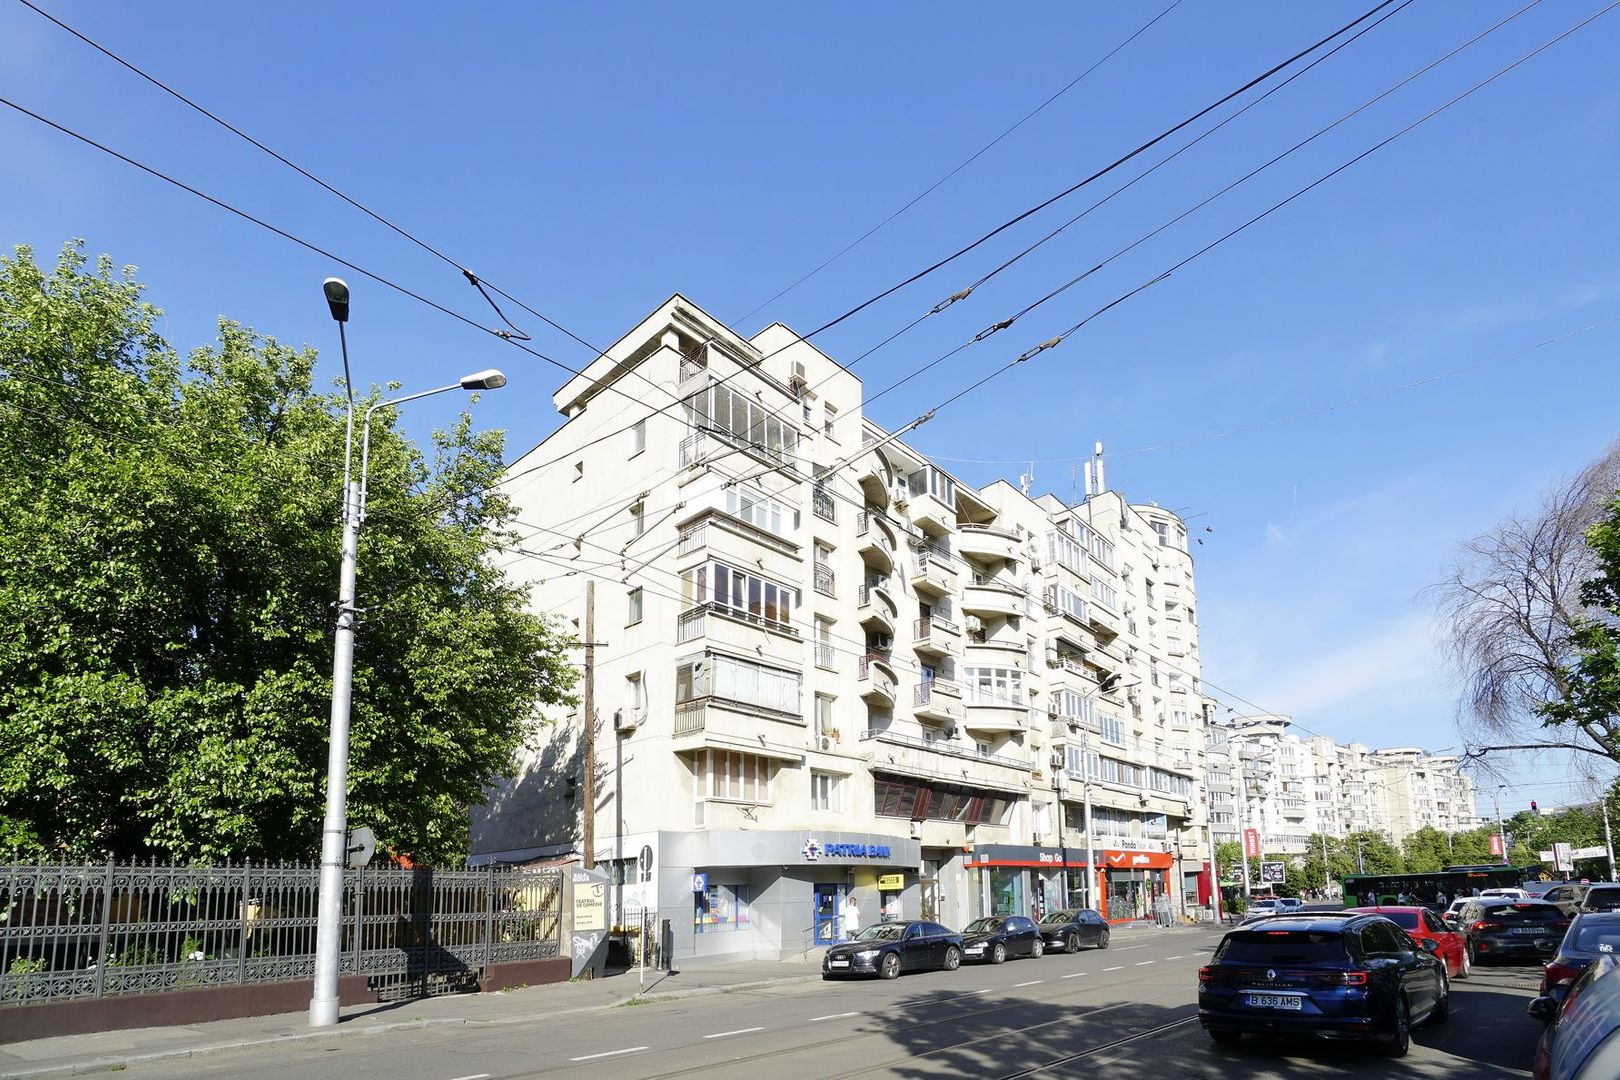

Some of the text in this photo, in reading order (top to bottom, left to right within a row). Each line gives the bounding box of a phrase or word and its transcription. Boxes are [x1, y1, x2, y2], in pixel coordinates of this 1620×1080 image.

[824, 843, 892, 859] PATRIA BANK
[1040, 852, 1062, 864] Shop Go
[1251, 996, 1300, 1006] B 636 AMS
